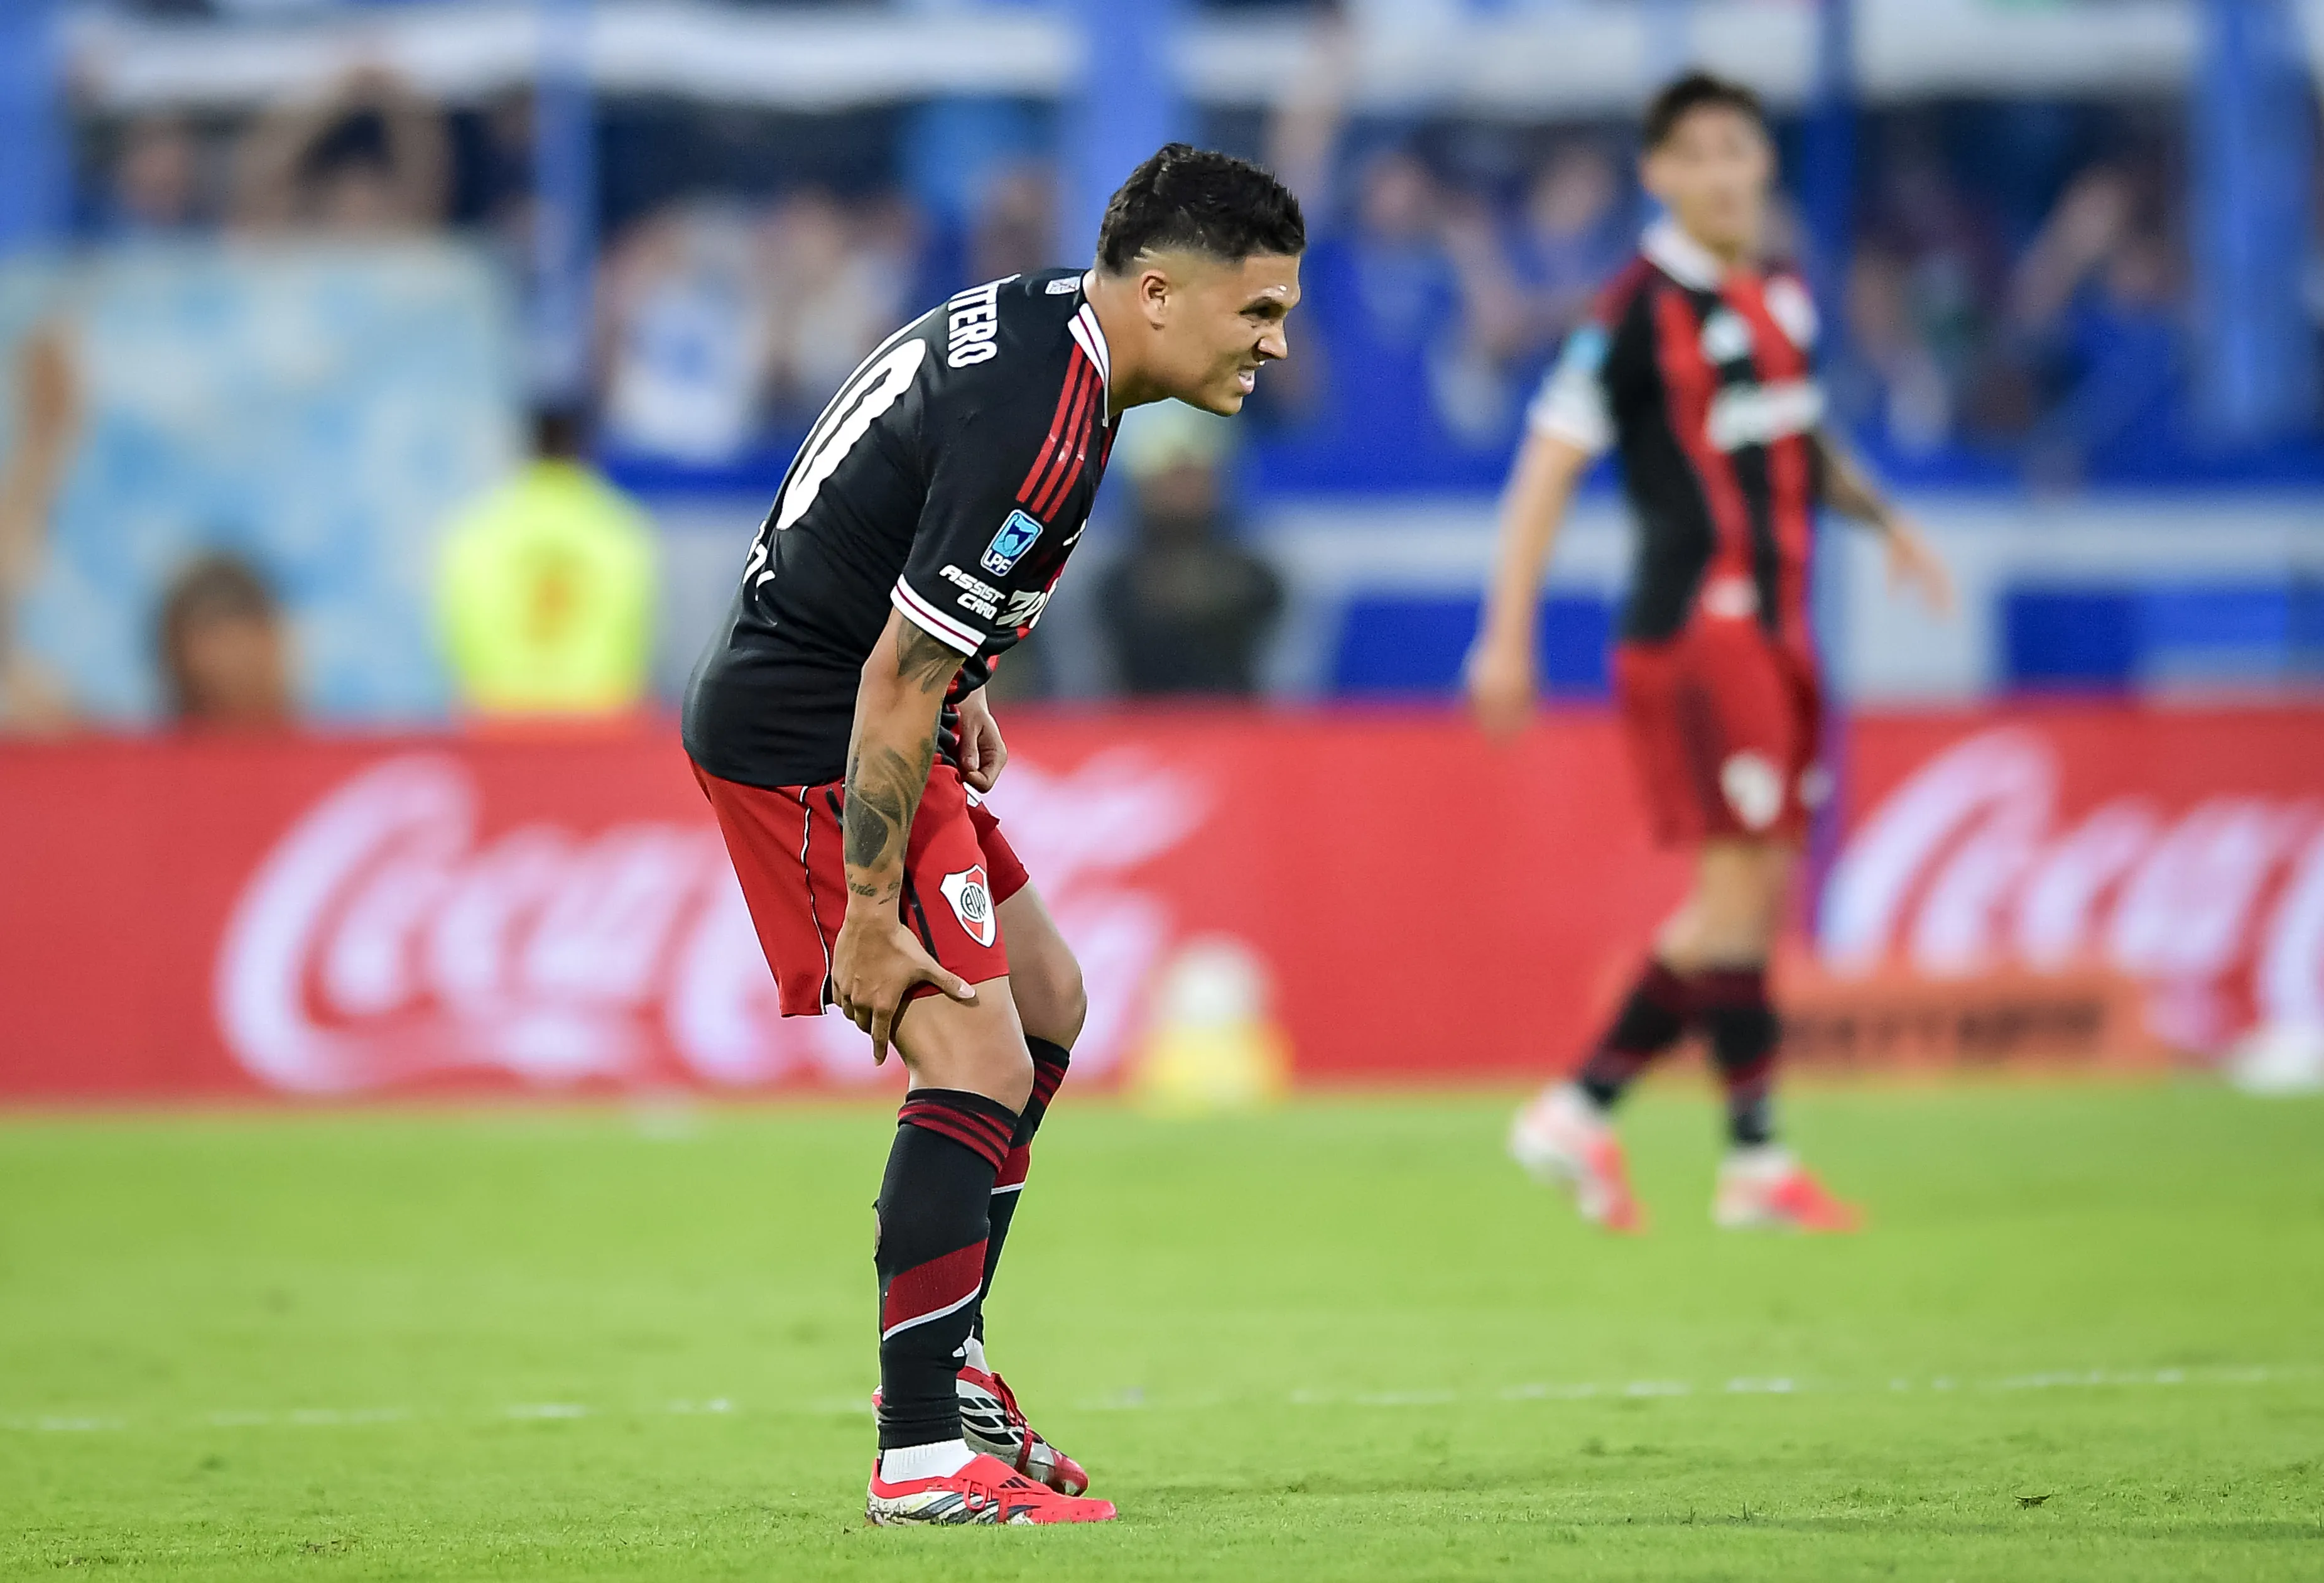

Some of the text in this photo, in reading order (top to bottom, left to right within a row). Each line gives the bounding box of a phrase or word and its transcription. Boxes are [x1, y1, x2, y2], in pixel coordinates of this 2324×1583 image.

[982, 548, 1013, 572] LPF
[938, 564, 1006, 604] ASSIST
[957, 592, 998, 621] CARD
